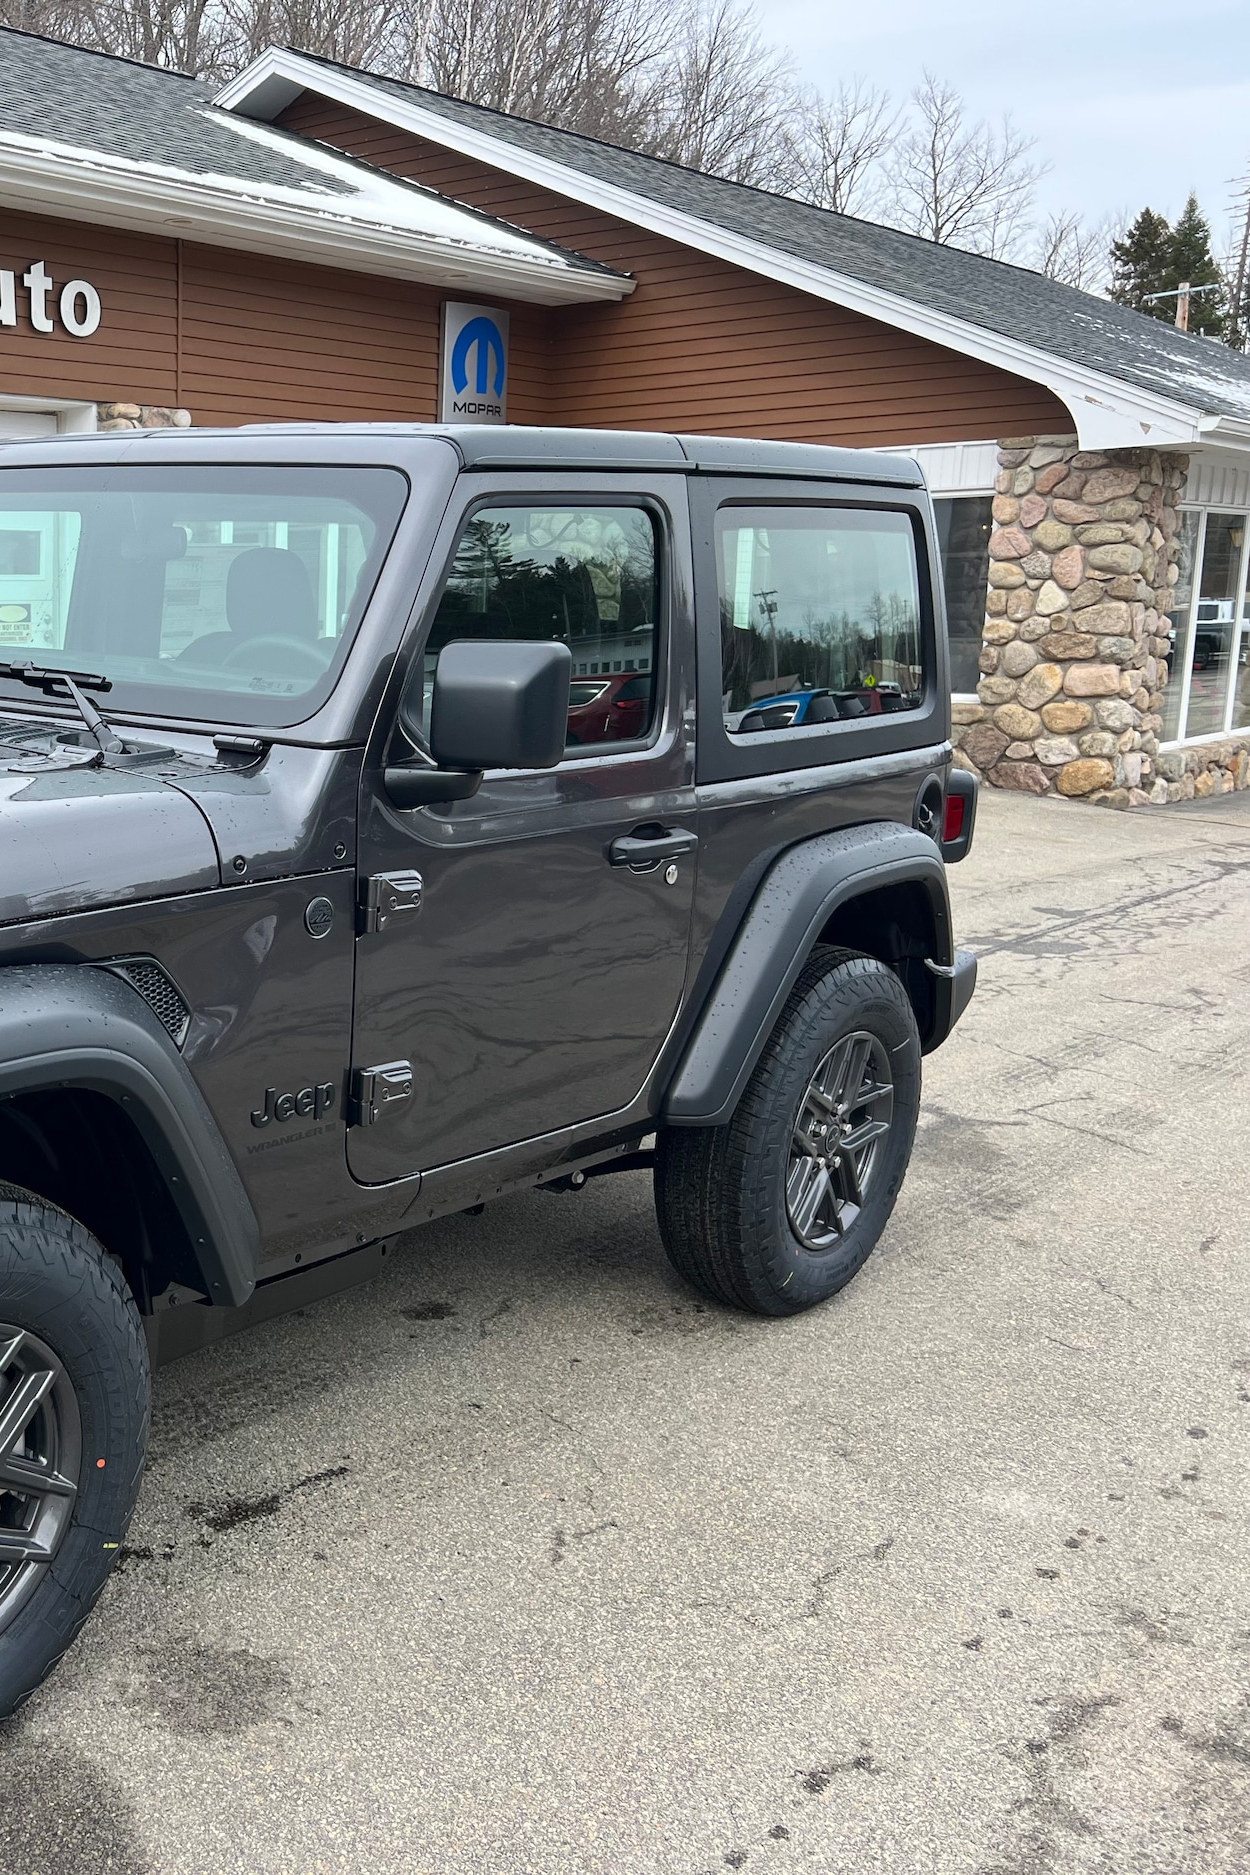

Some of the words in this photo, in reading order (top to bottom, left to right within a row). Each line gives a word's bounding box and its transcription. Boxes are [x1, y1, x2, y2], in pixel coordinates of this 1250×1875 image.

[452, 401, 502, 416] MOPAR
[250, 1082, 336, 1128] Jeep
[246, 1125, 324, 1155] WRANGLER
